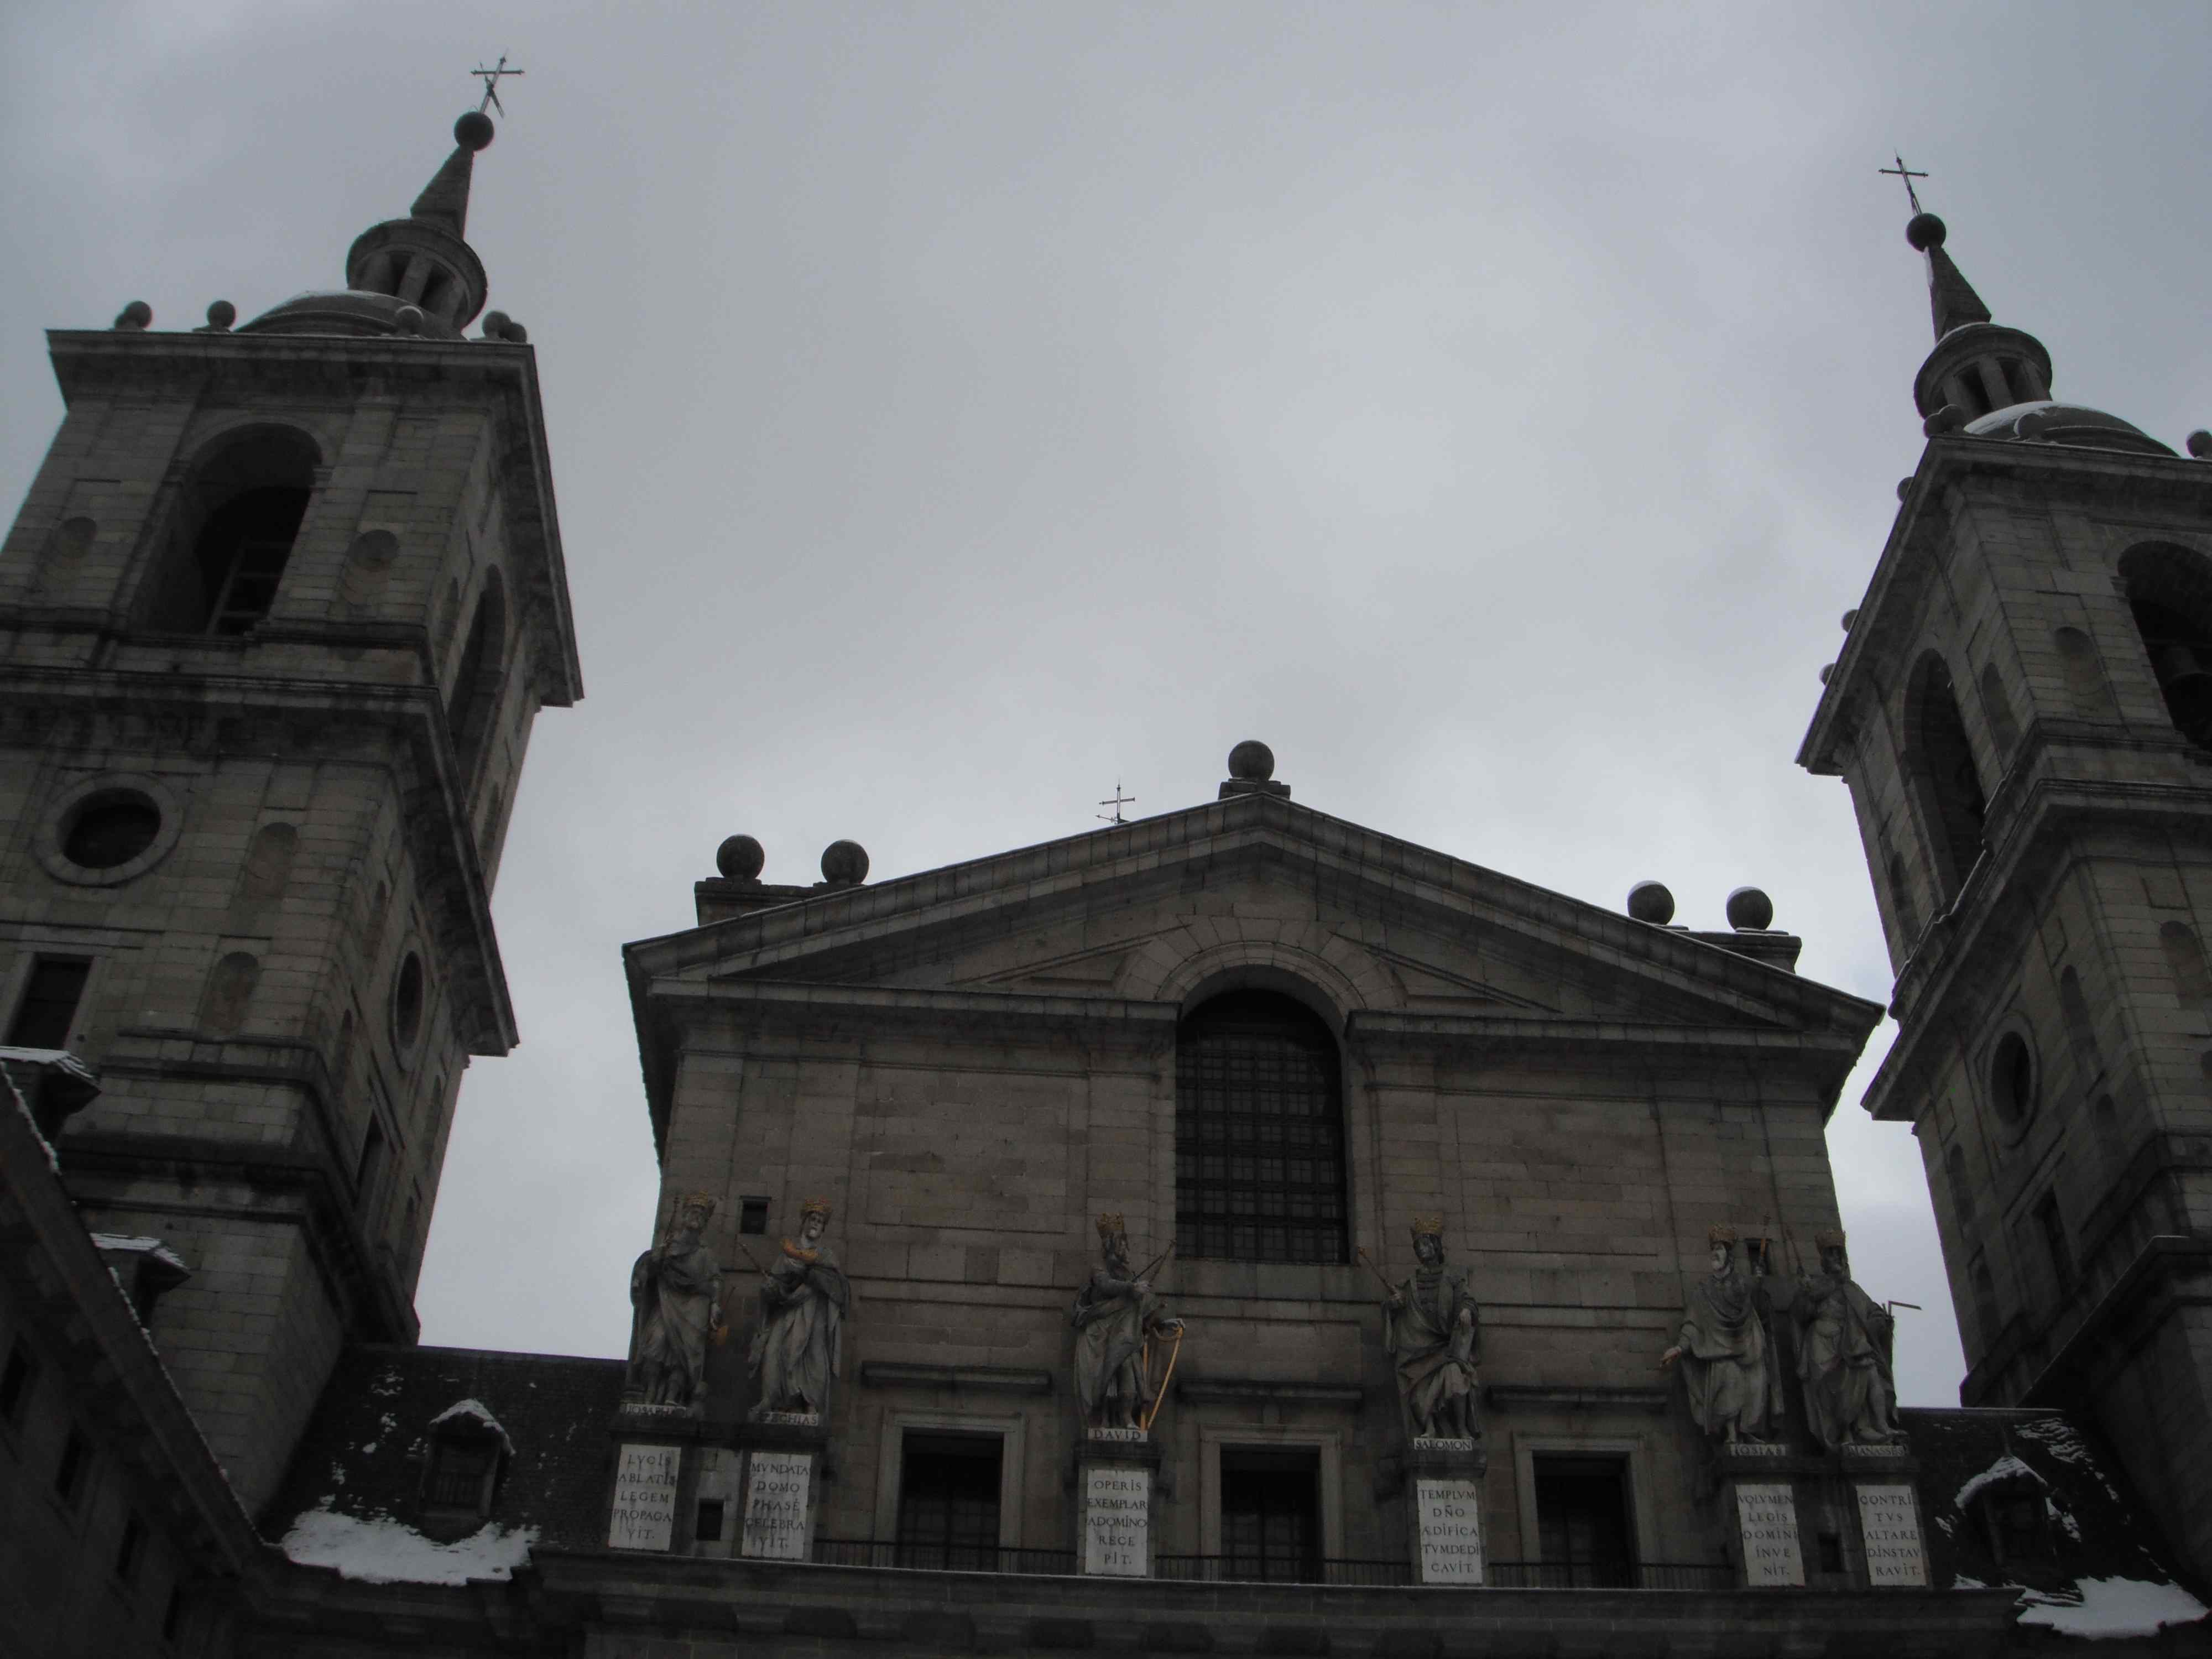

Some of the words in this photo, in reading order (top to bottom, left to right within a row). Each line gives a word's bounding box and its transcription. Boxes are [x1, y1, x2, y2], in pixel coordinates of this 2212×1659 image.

[1092, 1430, 1141, 1439] DAVID
[1416, 1439, 1472, 1450] SALOMON
[751, 1463, 809, 1475] MVNDATA
[618, 1472, 676, 1485] ABLATIS
[757, 1481, 800, 1493] DOMO
[1094, 1479, 1142, 1491] OPERIS
[620, 1491, 669, 1503] LEGEM
[1420, 1490, 1476, 1500] TEMPLVM
[1860, 1493, 1912, 1505] CONTRI
[1087, 1498, 1147, 1510] EXEMPLAR
[612, 1509, 672, 1522] PROPAGA
[1749, 1510, 1788, 1522] LEGIS
[1874, 1513, 1903, 1522] TVS
[745, 1517, 804, 1530] CELEBRA
[1099, 1535, 1135, 1547] RECE
[1866, 1530, 1917, 1540] ALTARE
[1756, 1545, 1791, 1558] INVE
